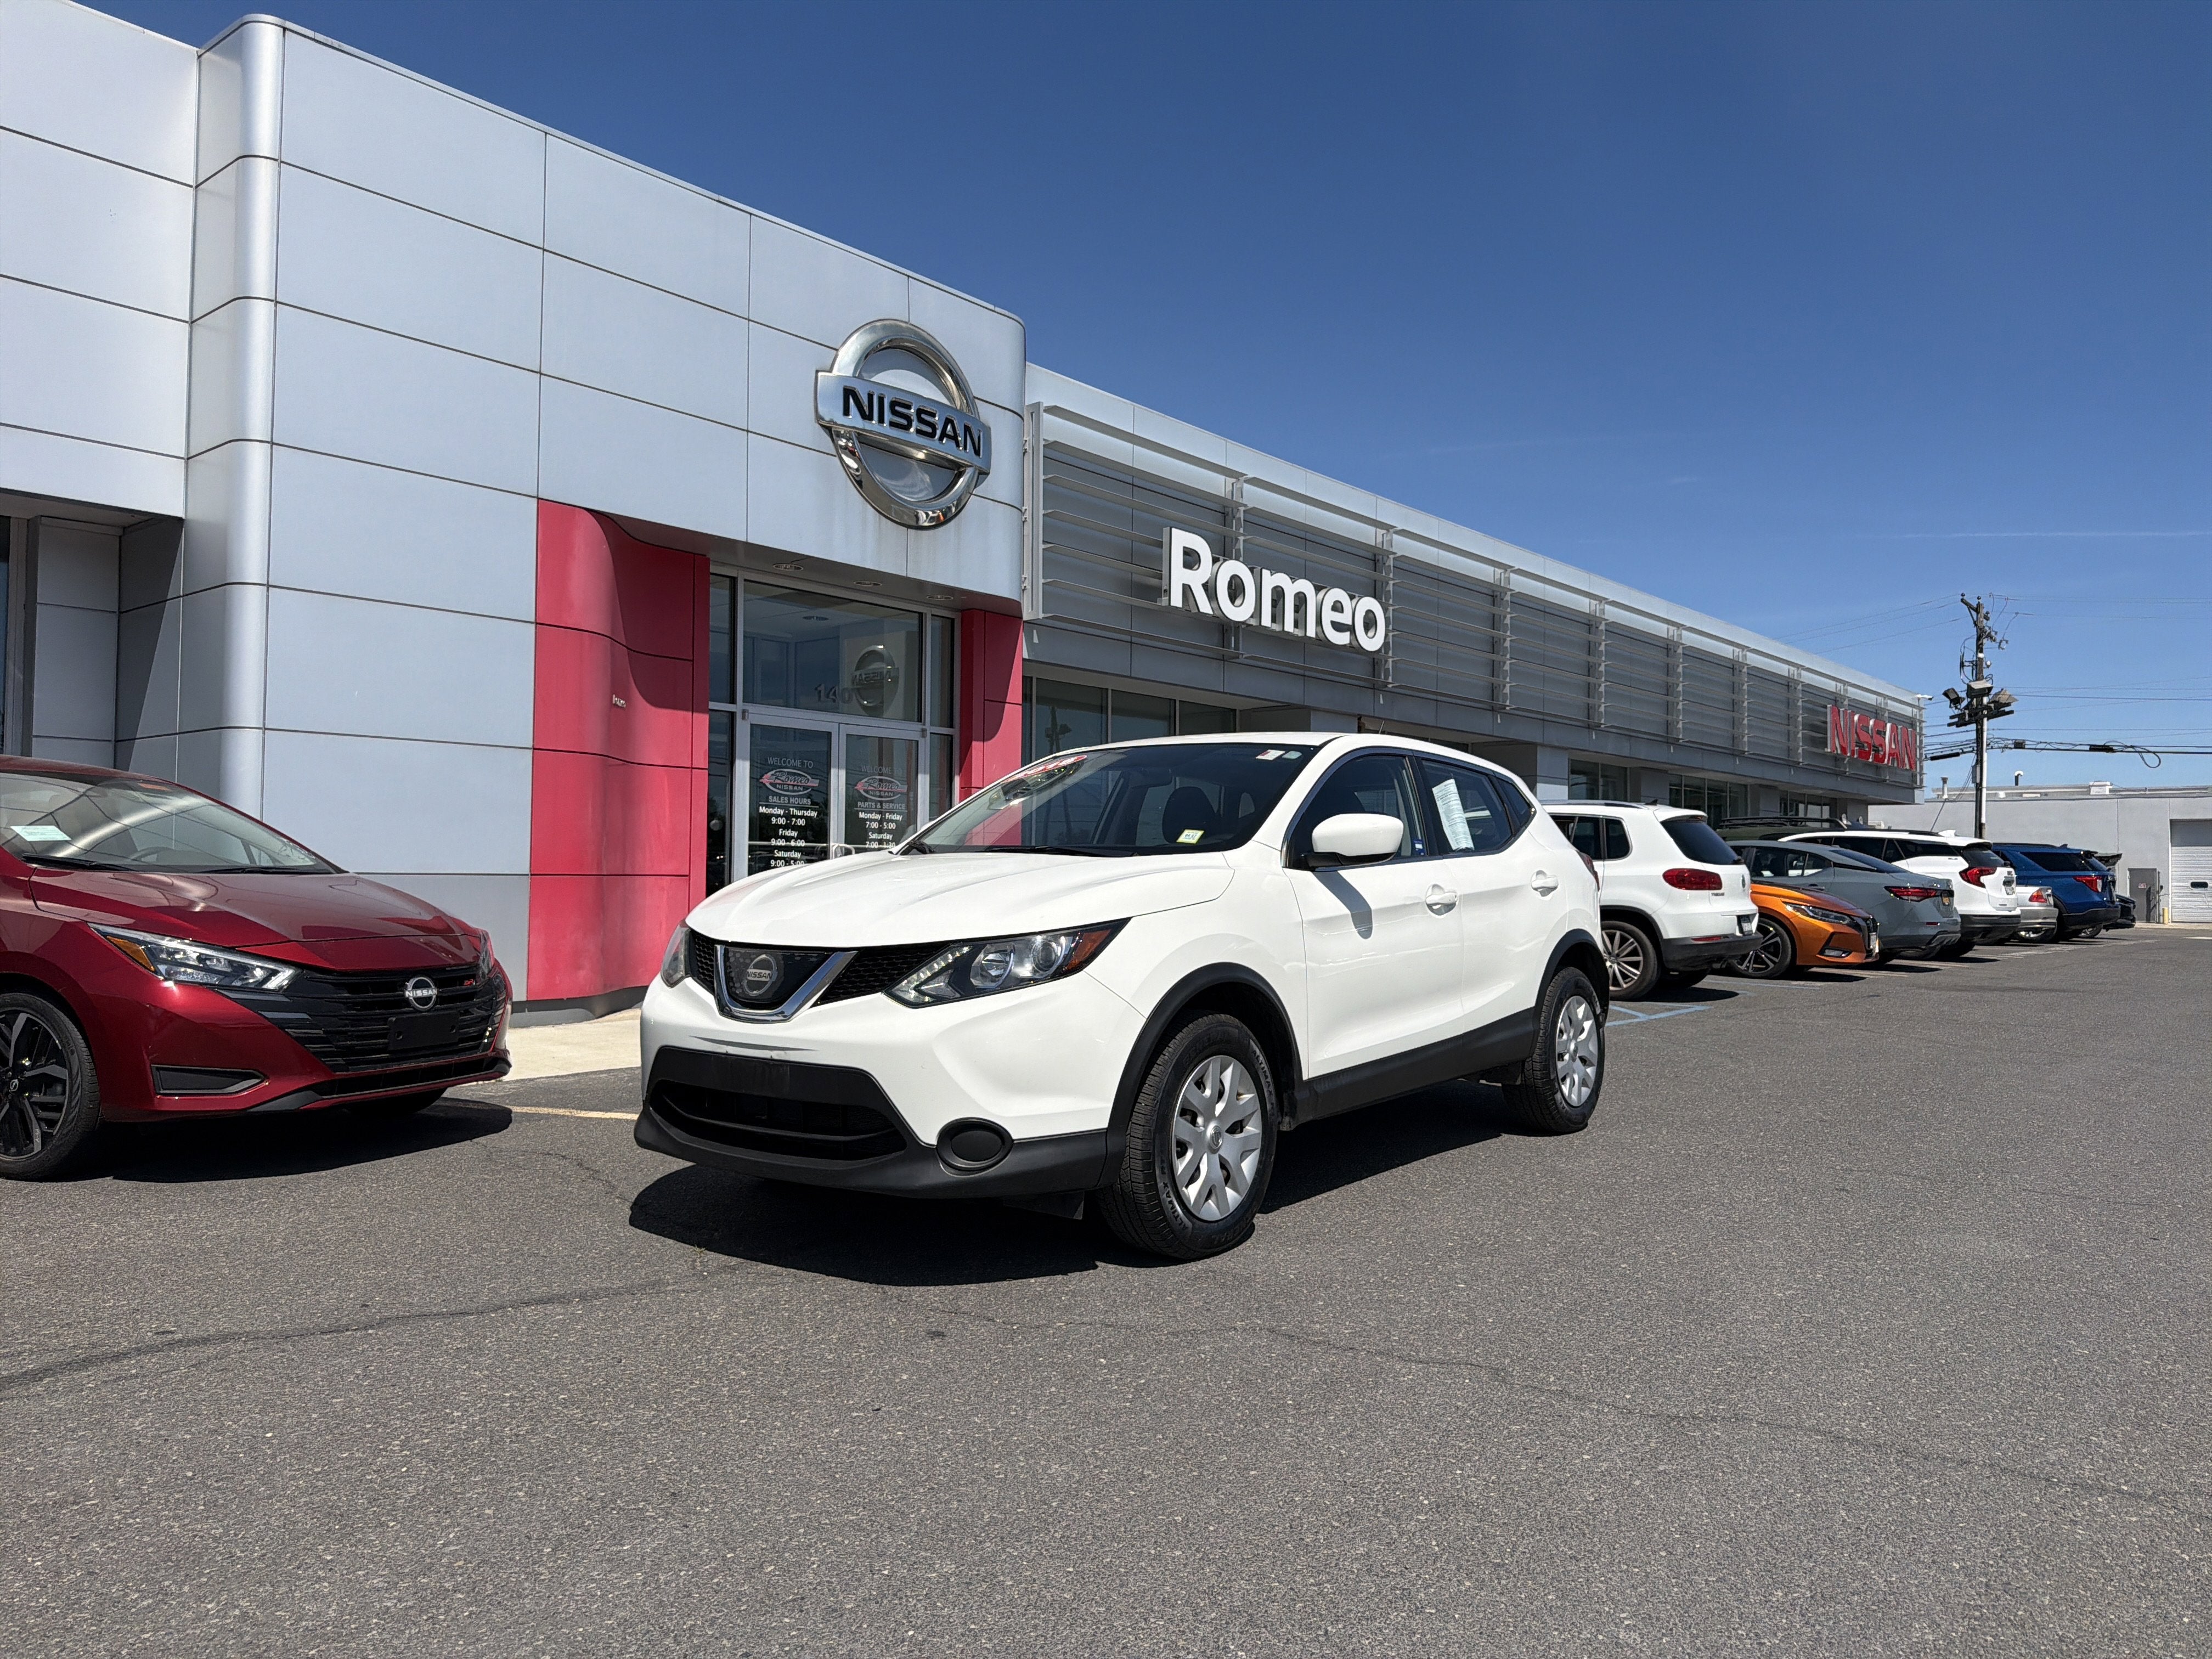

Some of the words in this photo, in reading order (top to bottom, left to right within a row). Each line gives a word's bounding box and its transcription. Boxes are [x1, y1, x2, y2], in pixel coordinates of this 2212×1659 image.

[843, 385, 983, 458] NISSAN
[1164, 527, 1386, 651] Romeo
[1827, 705, 1916, 770] NISSAN
[768, 757, 802, 768] WELCOME
[803, 760, 814, 768] TO
[861, 765, 891, 774] WELCOME
[771, 770, 810, 785] Romeo
[866, 777, 899, 790] Romeo
[790, 797, 811, 805] HOURS
[759, 805, 784, 816] Monday
[789, 808, 818, 818] Thursday
[859, 811, 882, 821] Monday
[885, 813, 903, 822] Friday
[771, 816, 786, 825] 9:00
[778, 828, 798, 838] Friday
[868, 832, 893, 840] Saturday
[771, 838, 786, 846] 9:00
[774, 849, 802, 859] Saturday
[746, 971, 773, 979] NISSAN
[406, 989, 437, 997] NISSAN
[1251, 1049, 1273, 1096] ALTIMAX
[1163, 1181, 1188, 1229] ALTIMAX
